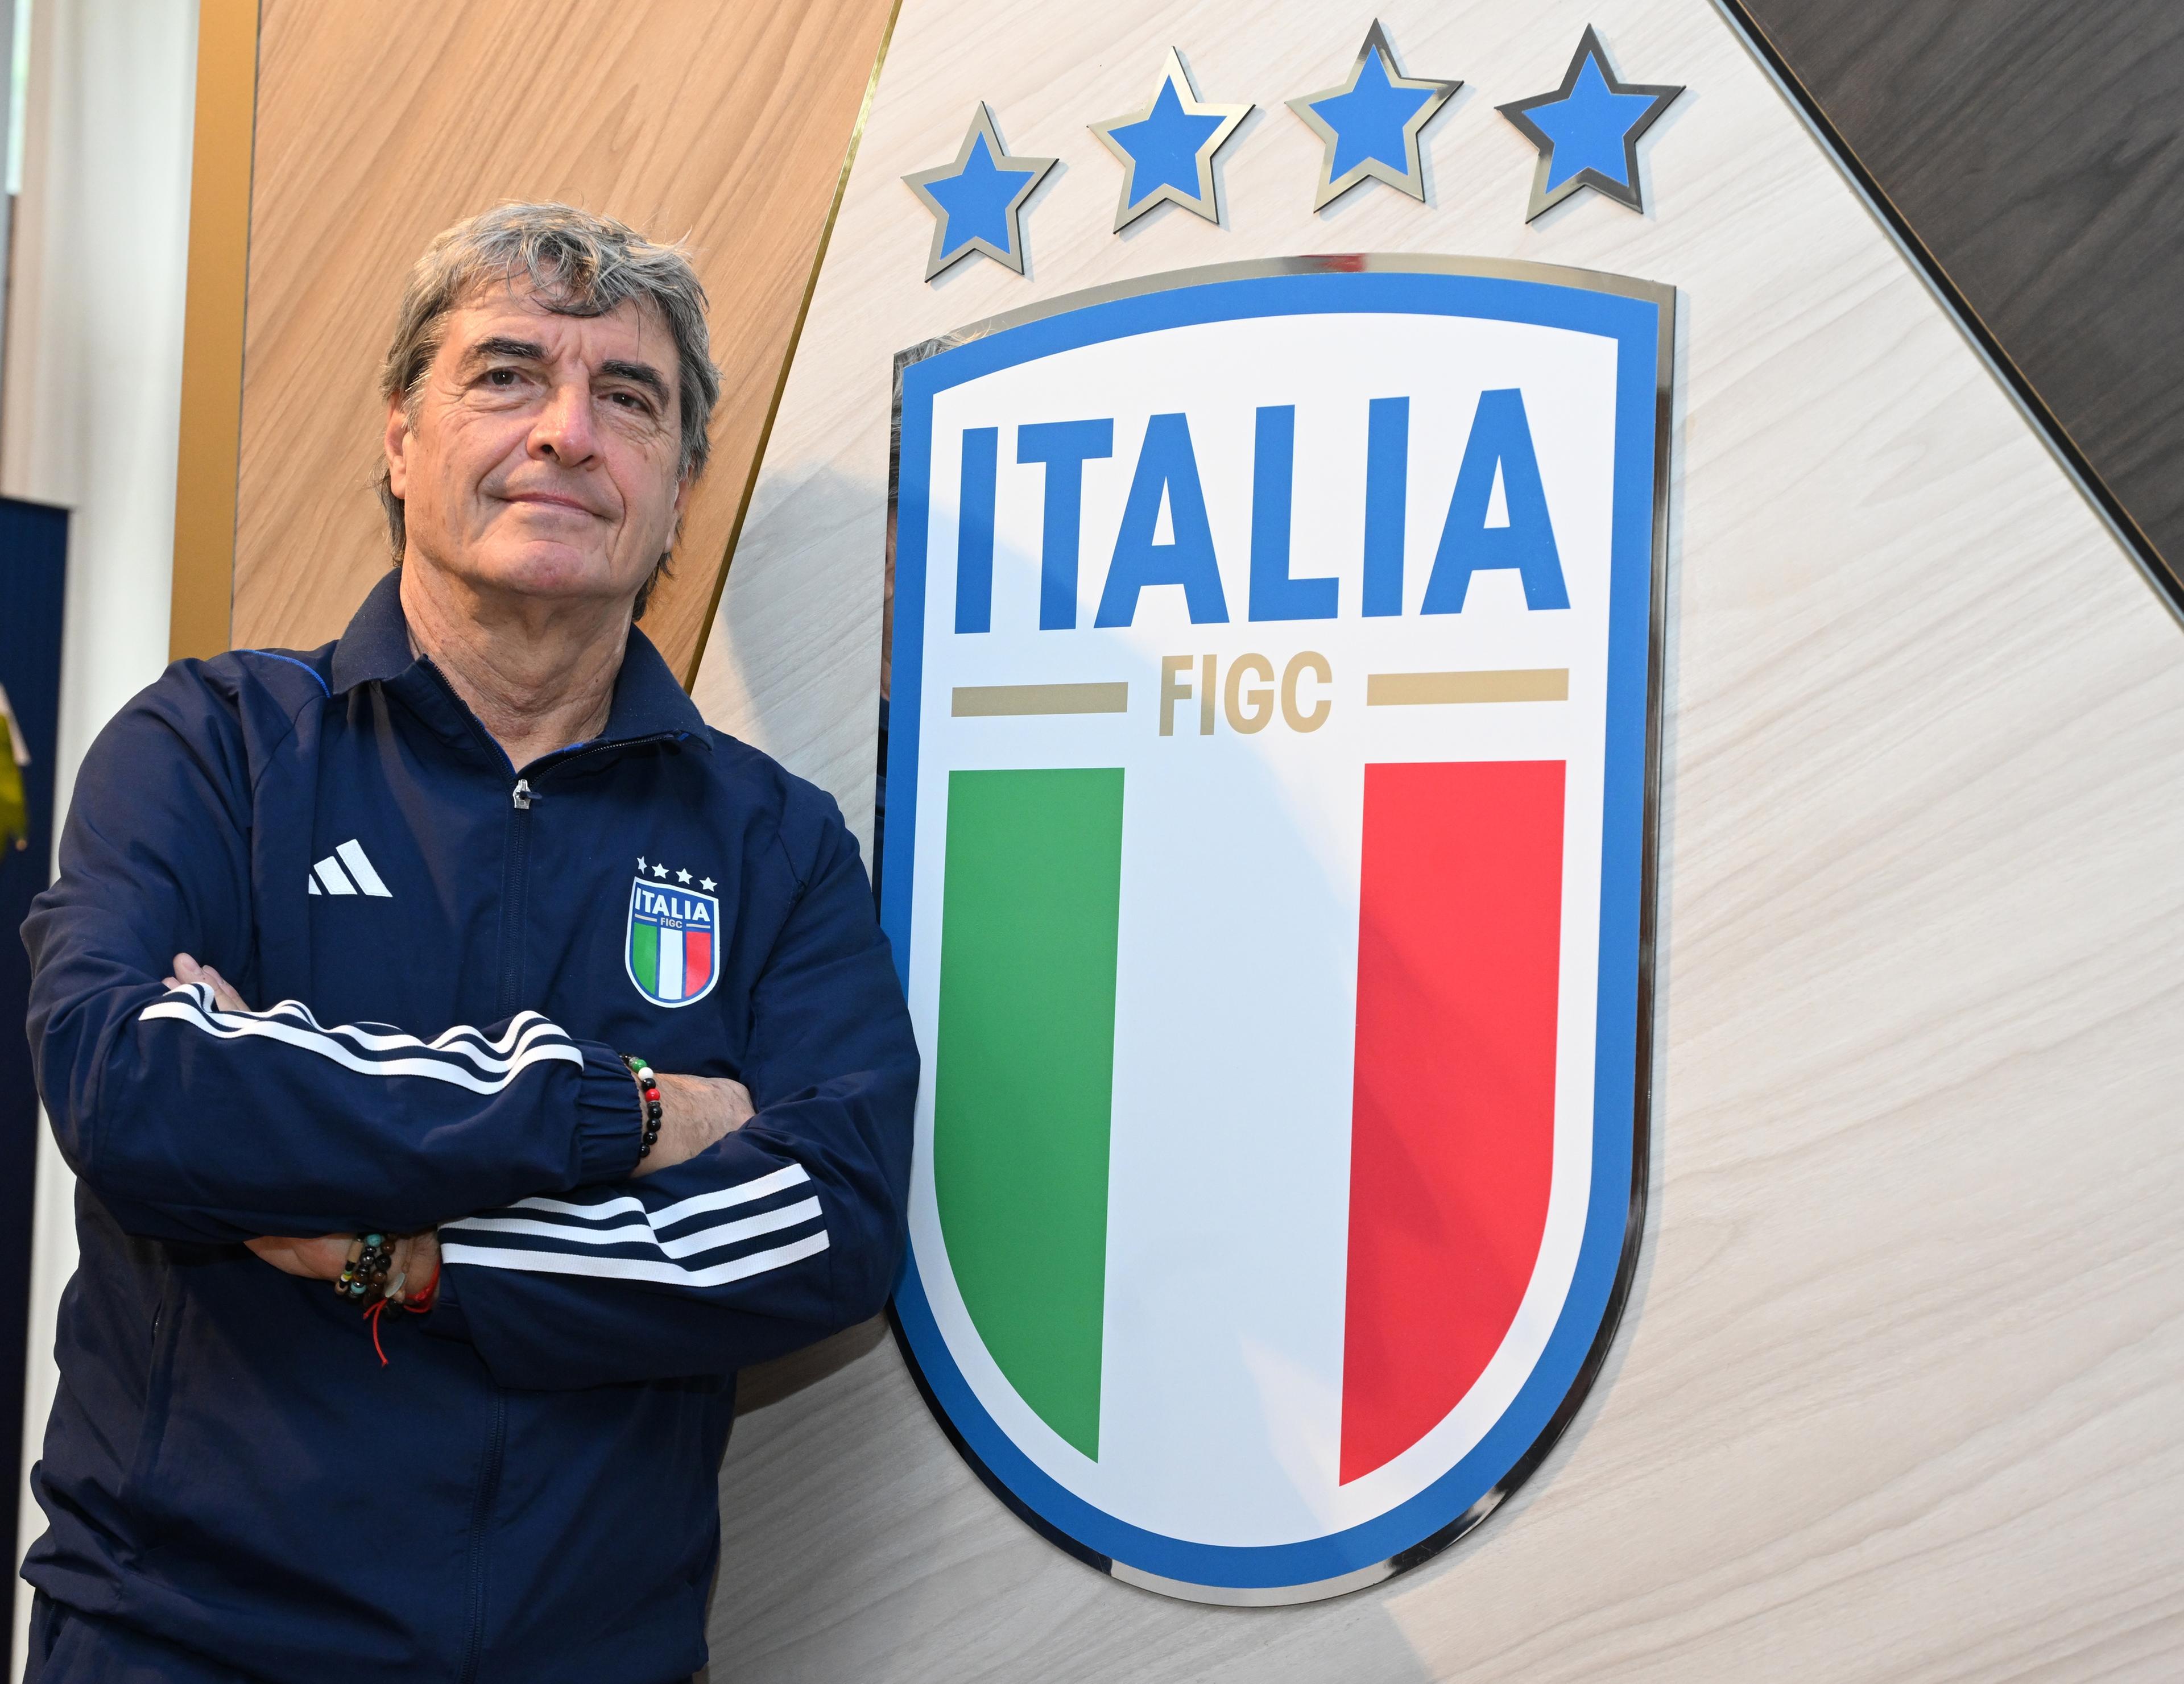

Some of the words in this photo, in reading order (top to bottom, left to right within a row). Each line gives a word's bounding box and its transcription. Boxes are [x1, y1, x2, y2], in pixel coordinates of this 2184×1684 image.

[954, 388, 1571, 634] ITALIA
[1159, 651, 1332, 736] FIGC
[635, 887, 710, 921] ITALIA
[660, 917, 682, 928] FIGC
